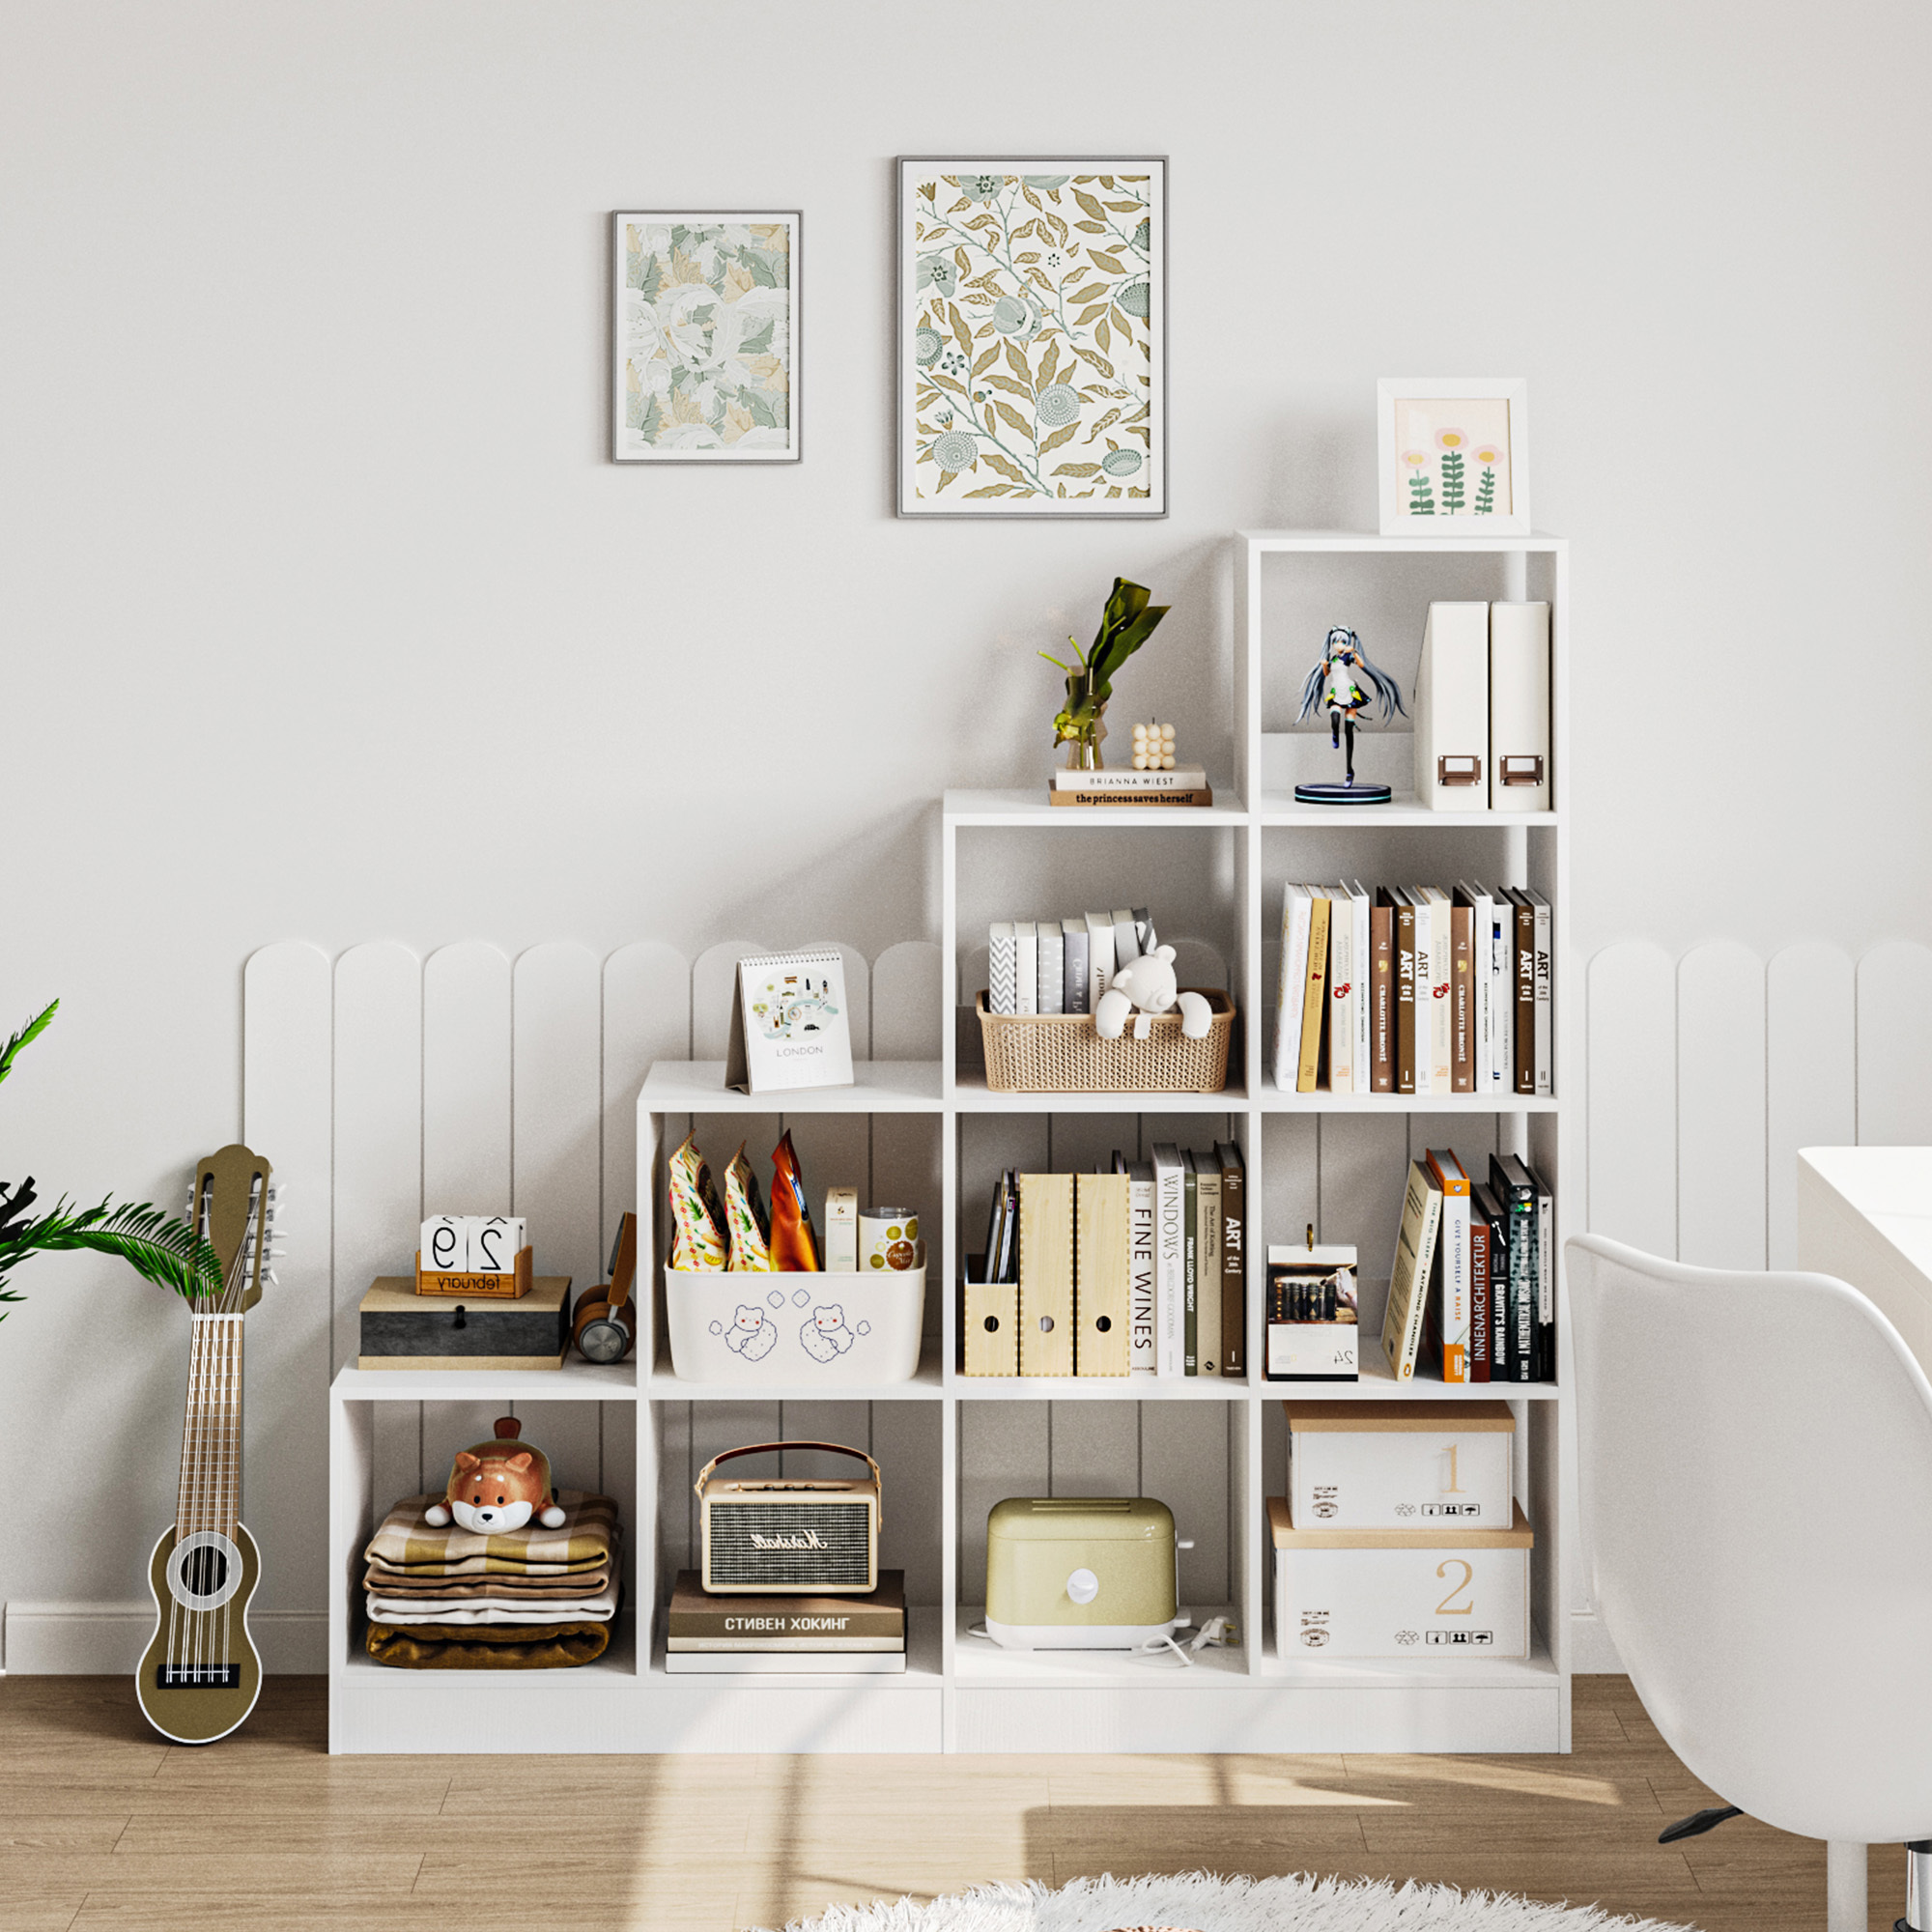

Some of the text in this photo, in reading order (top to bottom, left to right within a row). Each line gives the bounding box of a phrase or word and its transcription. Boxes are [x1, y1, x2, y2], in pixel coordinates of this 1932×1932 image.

[1076, 794, 1092, 803] the
[1093, 794, 1132, 806] princess
[1160, 794, 1194, 803] herself
[1401, 950, 1413, 980] ART
[1418, 951, 1428, 980] ART
[1520, 951, 1532, 980] ART
[1538, 951, 1548, 980] ART
[777, 1046, 823, 1057] LONDON
[1134, 1209, 1151, 1260] FINE
[1163, 1175, 1179, 1260] WINDOWS
[1225, 1217, 1240, 1251] ART
[1134, 1271, 1151, 1349] WINES
[1415, 1269, 1426, 1312] RAYMOND
[1474, 1235, 1485, 1360] INNENARCHITEKTUR
[1408, 1314, 1419, 1356] CHANDLER
[1494, 1284, 1505, 1365] GRAVITY'S RAINBOW
[1518, 1304, 1530, 1349] MATHEMATICAL
[1441, 1444, 1466, 1493] 1
[1435, 1559, 1474, 1615] 2
[724, 1617, 850, 1631] СТИВЕН ХОКИНГ
